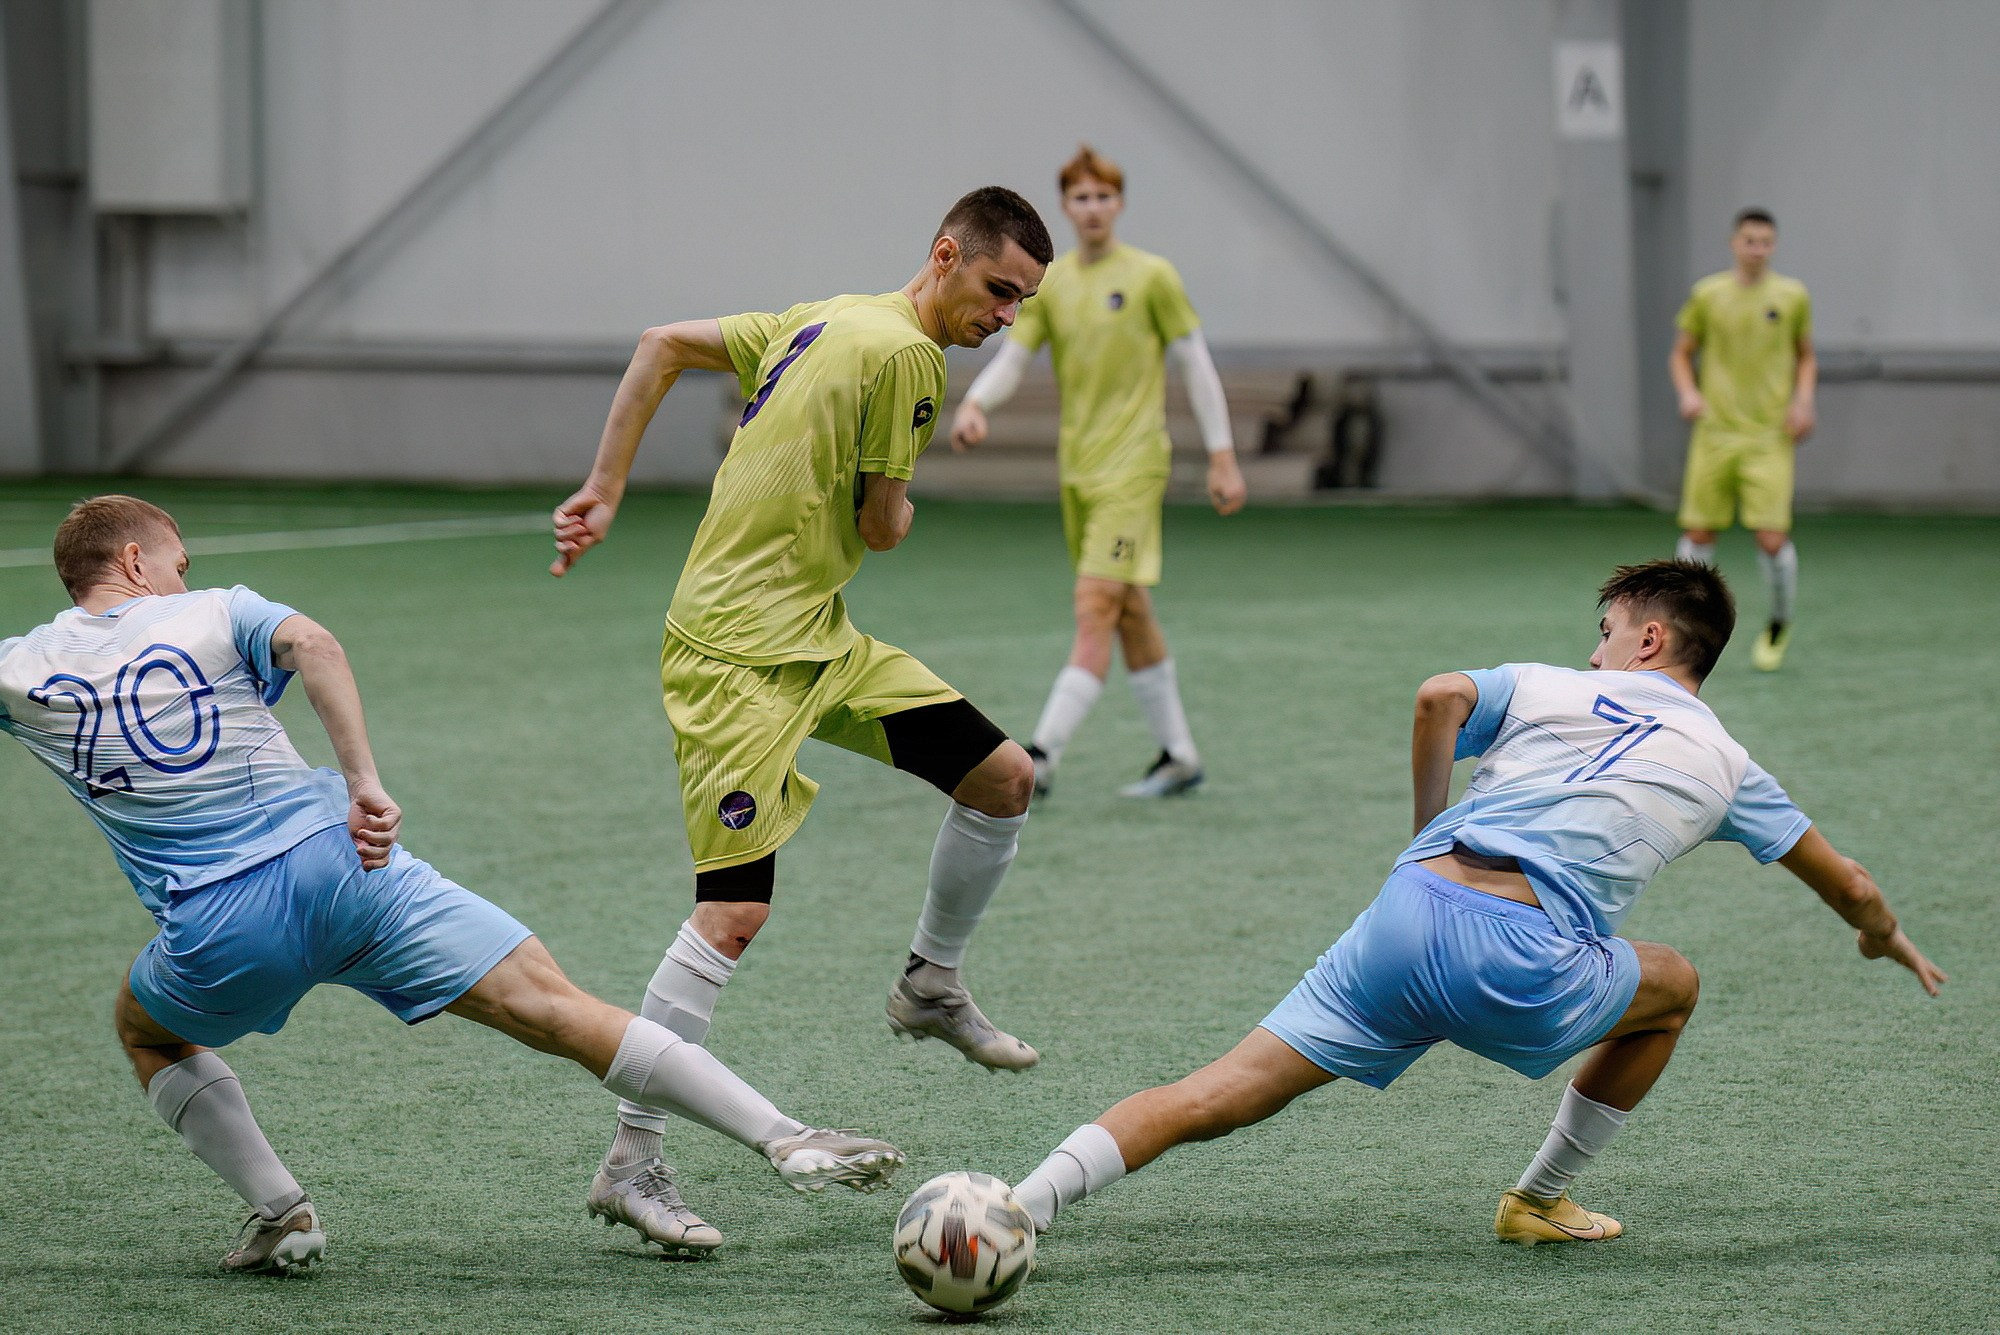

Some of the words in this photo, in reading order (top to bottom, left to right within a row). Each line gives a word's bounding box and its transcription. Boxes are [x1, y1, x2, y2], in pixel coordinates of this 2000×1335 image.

[1567, 66, 1609, 112] A
[28, 643, 221, 799] 20
[1562, 694, 1663, 783] 7
